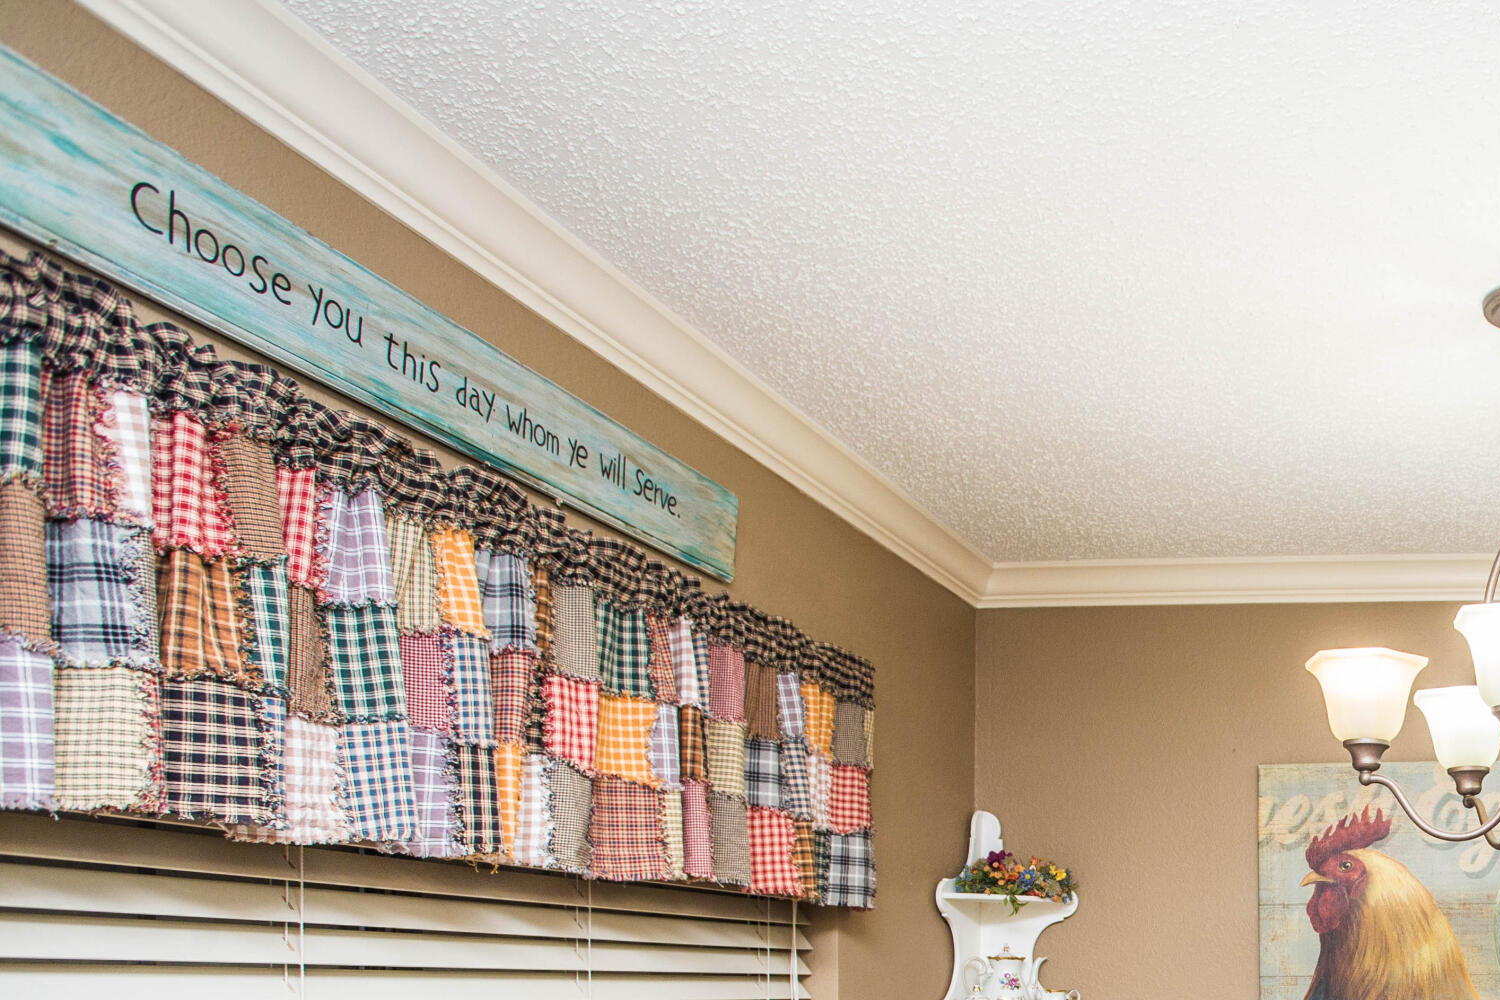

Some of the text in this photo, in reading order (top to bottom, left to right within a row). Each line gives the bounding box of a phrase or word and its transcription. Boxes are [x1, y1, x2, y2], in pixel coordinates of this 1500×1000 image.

[131, 182, 292, 305] Choose
[308, 284, 363, 347] you
[506, 404, 560, 456] whom
[568, 438, 589, 468] ye
[599, 452, 627, 490] will
